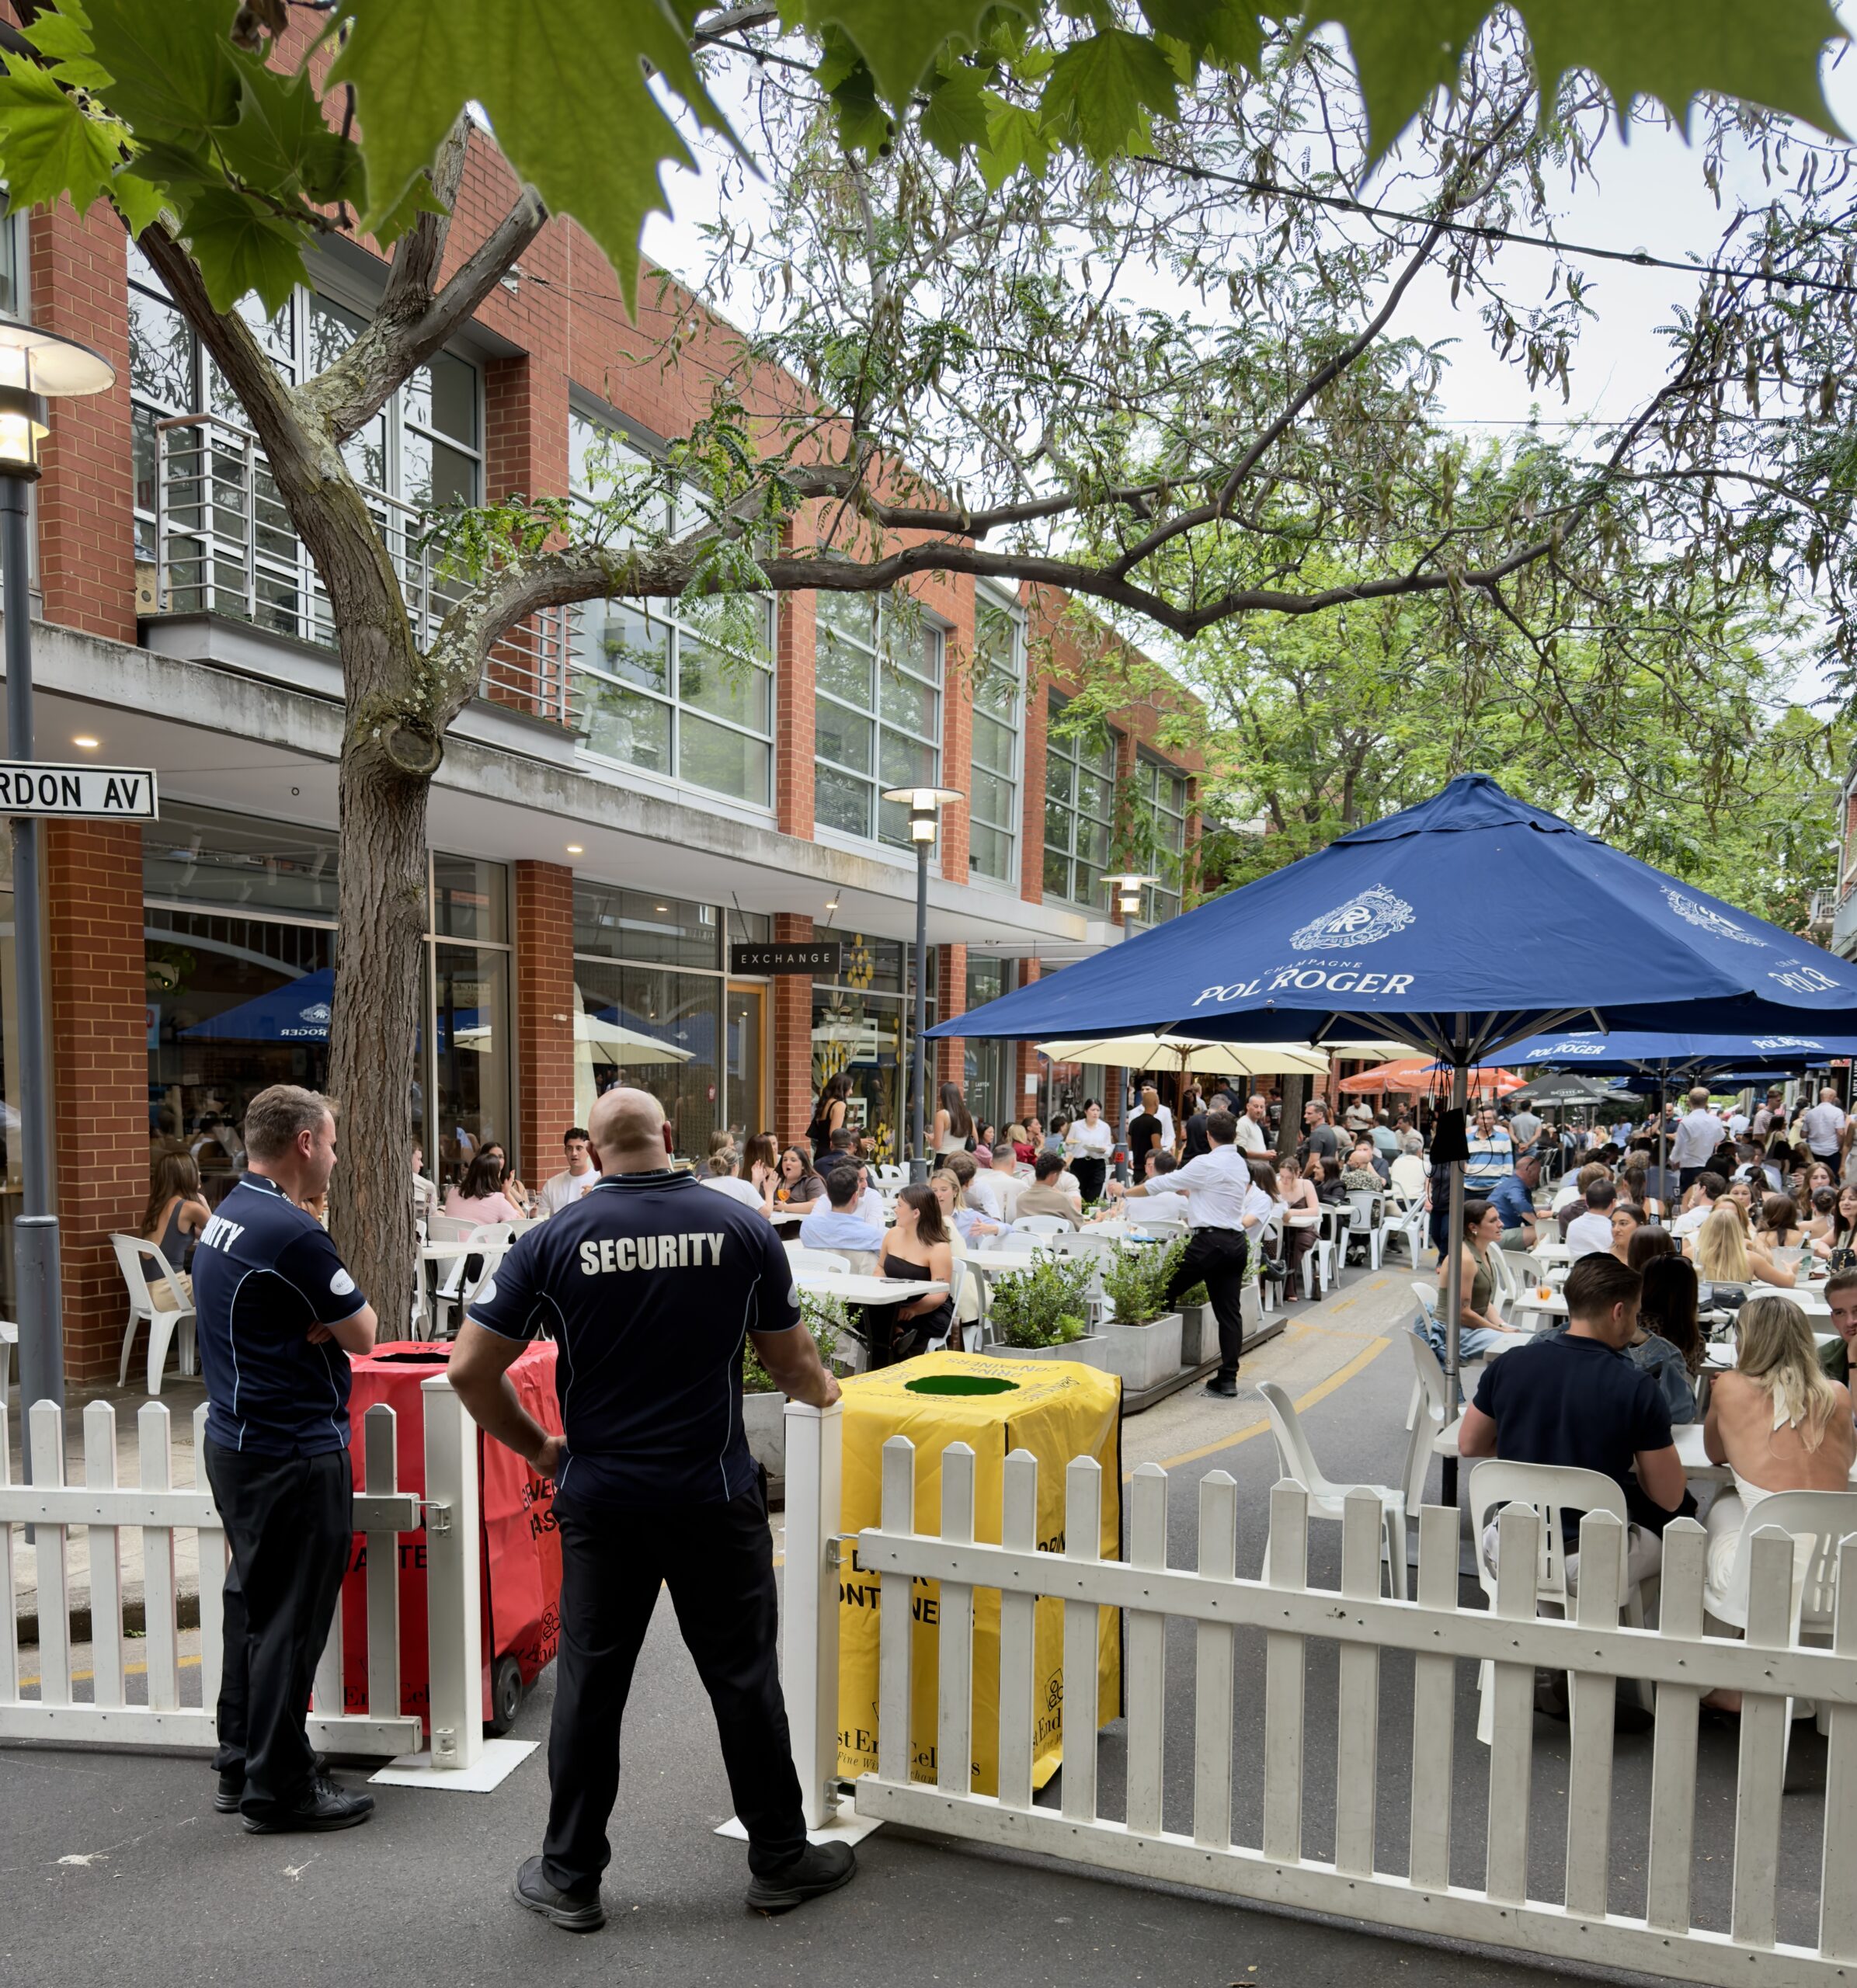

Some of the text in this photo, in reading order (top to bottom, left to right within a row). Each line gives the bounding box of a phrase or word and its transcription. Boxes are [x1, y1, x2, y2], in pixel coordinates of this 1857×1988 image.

[103, 777, 140, 809] AV
[741, 953, 829, 964] EXCHANGE
[1264, 958, 1363, 975] CHAMPAGNE
[1191, 968, 1414, 1006] POL ROGER
[1768, 971, 1827, 993] POL
[1525, 1044, 1606, 1058] POL ROGER
[1650, 1215, 1660, 1225] 68
[579, 1232, 725, 1276] SECURITY
